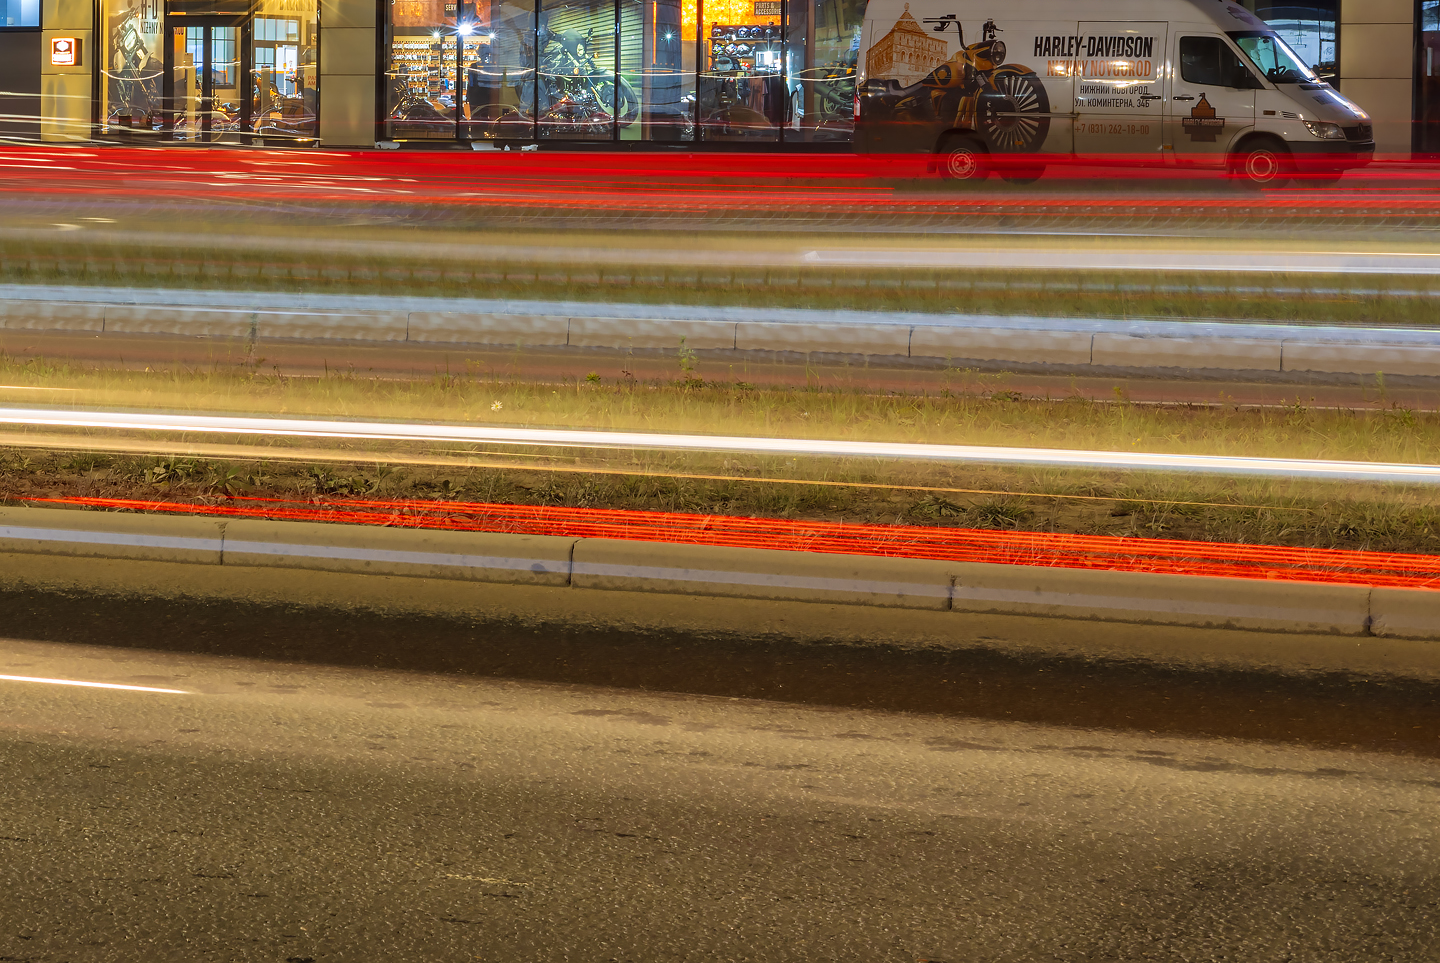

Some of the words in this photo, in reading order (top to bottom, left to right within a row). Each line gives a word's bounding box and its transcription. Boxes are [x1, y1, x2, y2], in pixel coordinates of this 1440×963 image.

[1034, 36, 1153, 57] HARLEY-DAVIDSON
[1075, 124, 1086, 133] +7
[1088, 124, 1107, 135] (831)
[1108, 124, 1150, 135] 262-18-00
